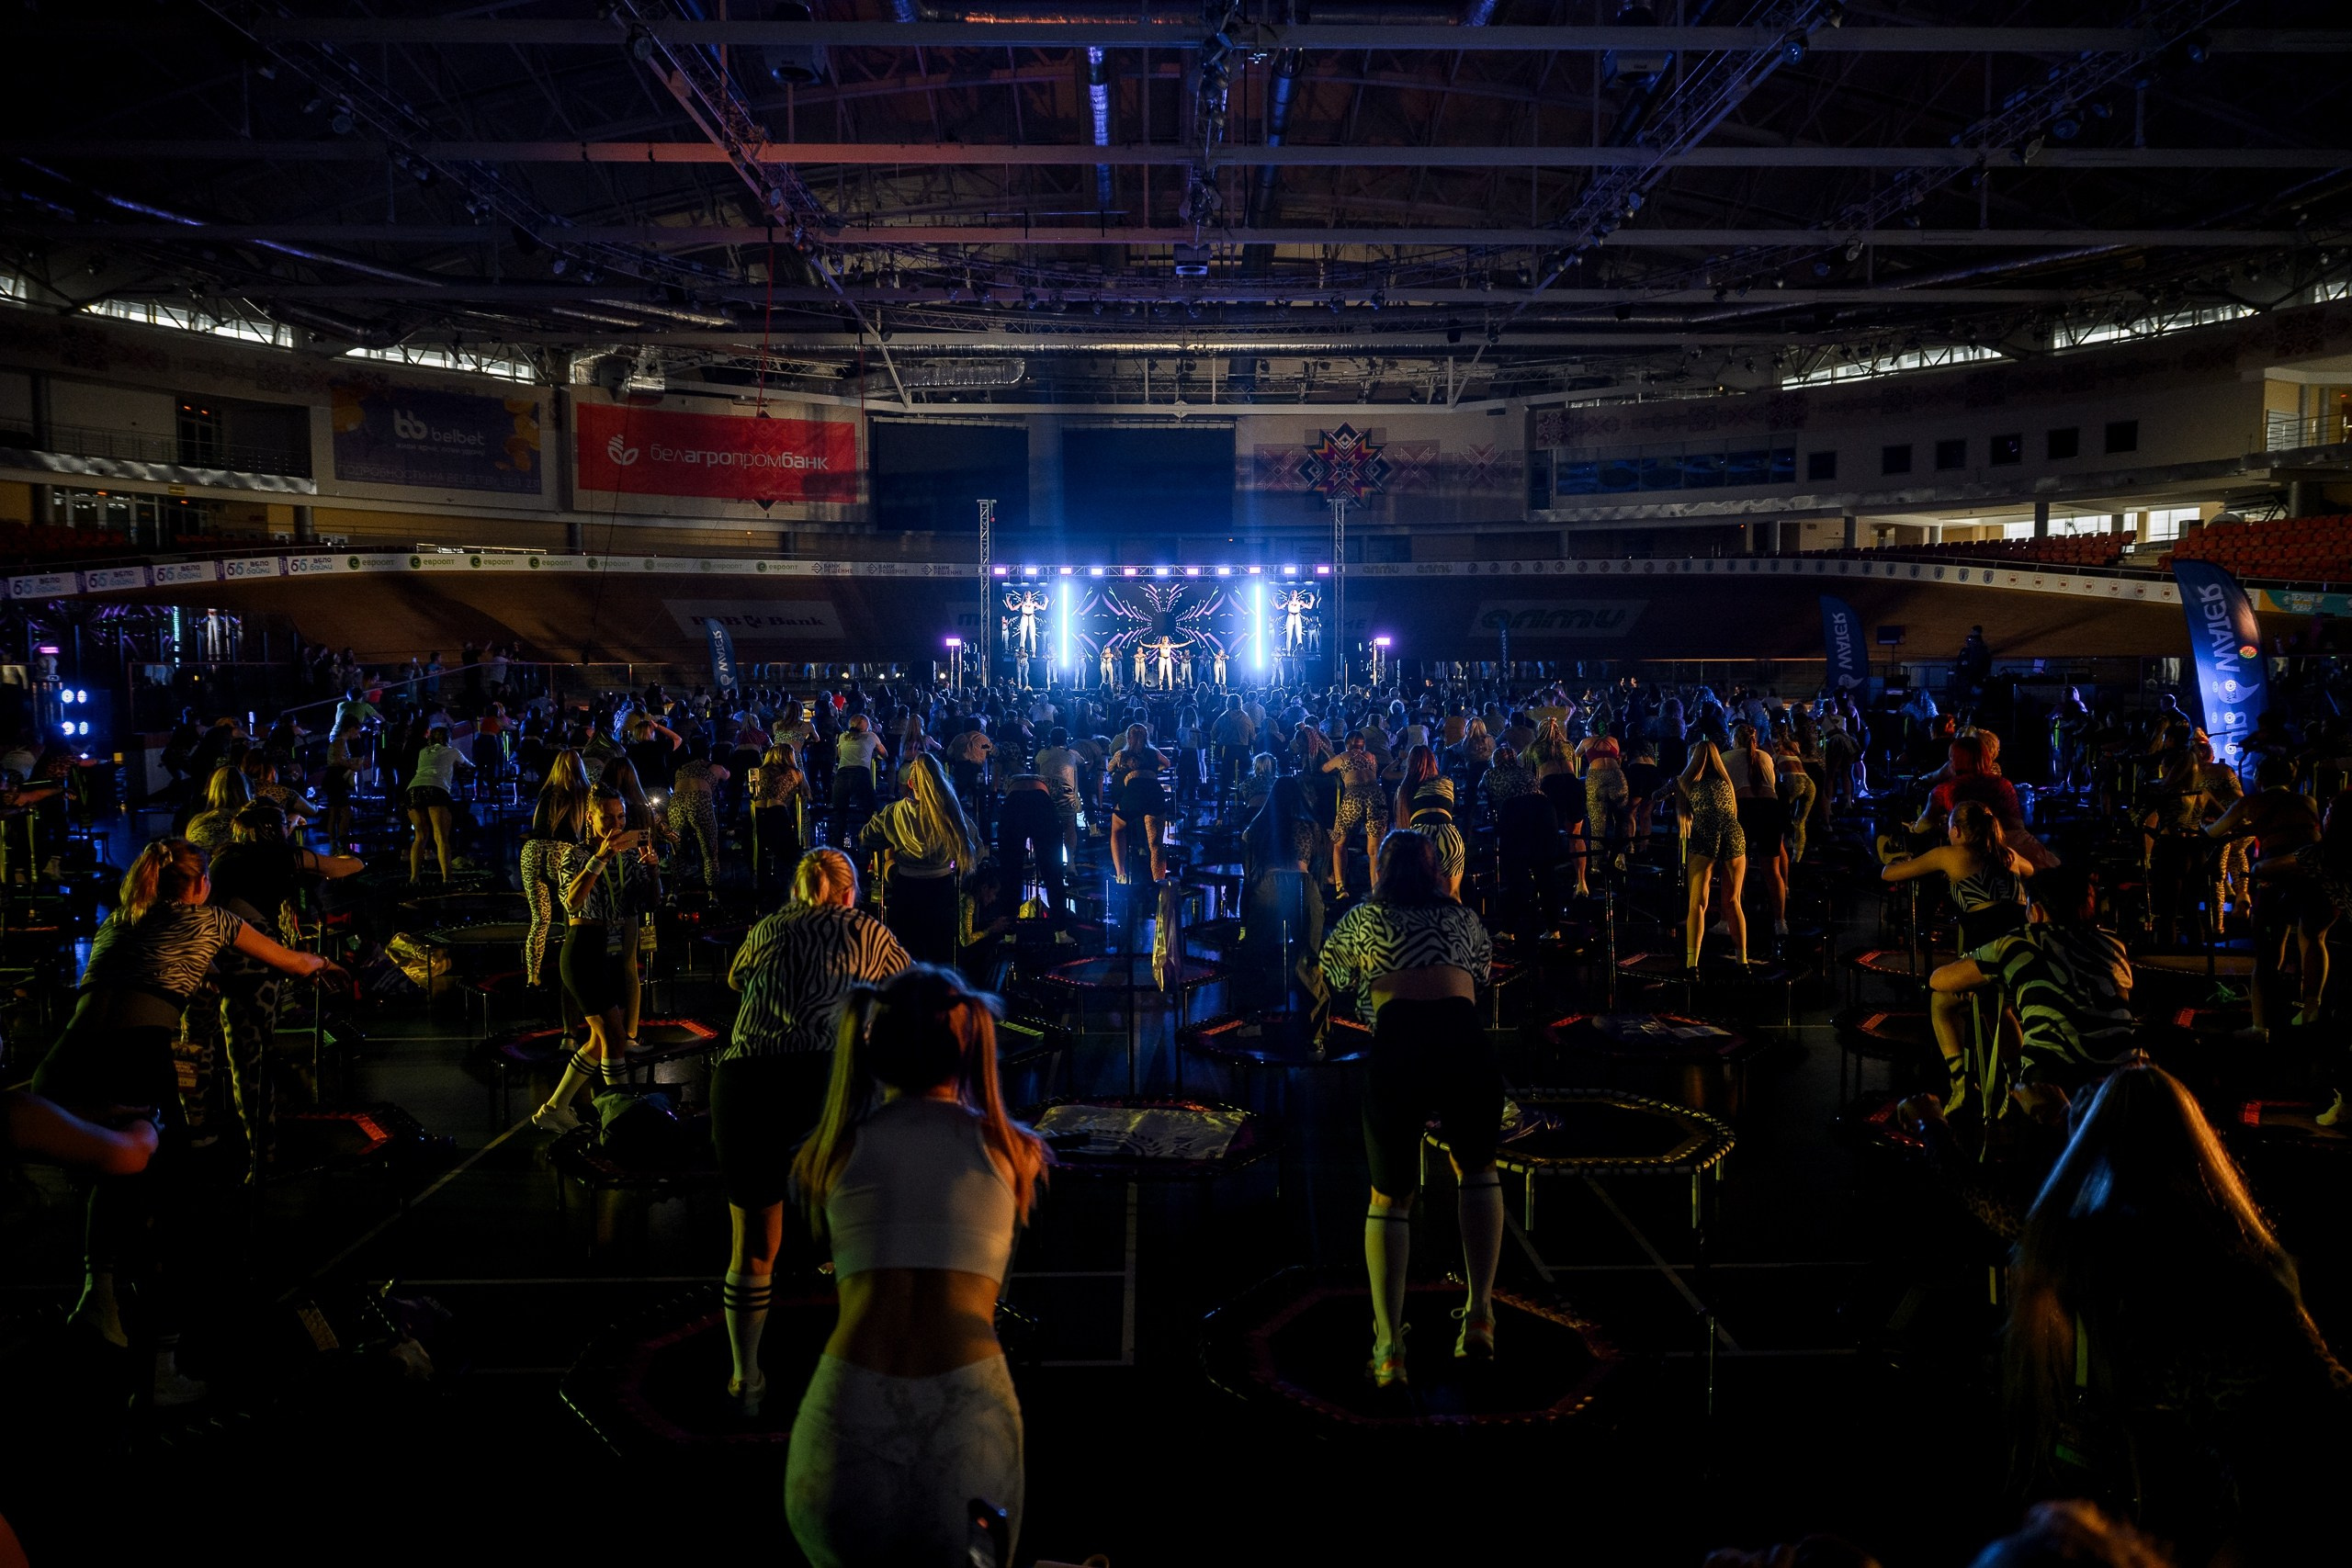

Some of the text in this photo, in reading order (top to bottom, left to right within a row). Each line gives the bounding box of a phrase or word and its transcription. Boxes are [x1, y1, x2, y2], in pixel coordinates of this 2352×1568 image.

[431, 426, 485, 446] belbet
[650, 443, 829, 470] белагропромбанк
[361, 558, 395, 567] евроопт
[423, 558, 456, 567] евроопт
[483, 558, 514, 567] евроопт
[541, 558, 573, 568] евроопт
[768, 563, 799, 571] евроопт
[767, 616, 825, 626] Bank
